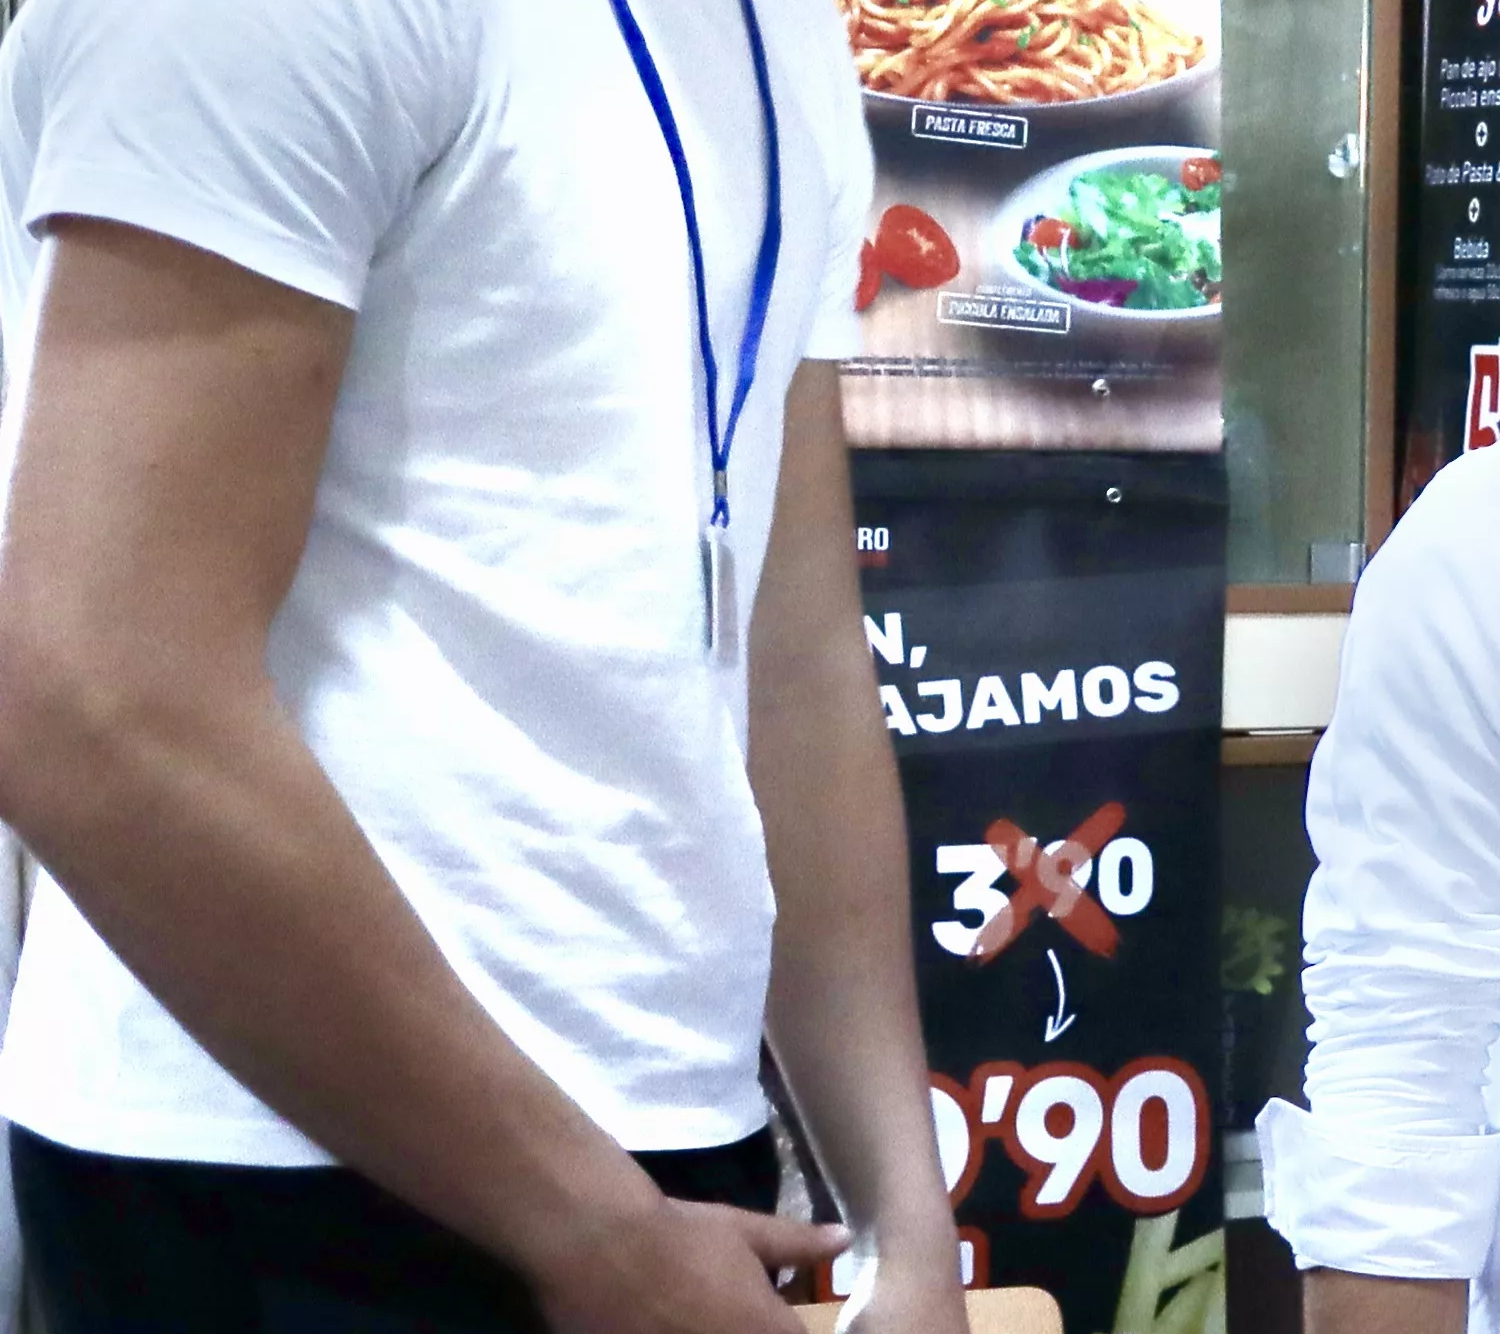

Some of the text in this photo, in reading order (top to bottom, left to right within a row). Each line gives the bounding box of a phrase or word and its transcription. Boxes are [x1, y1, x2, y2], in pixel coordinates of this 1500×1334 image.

[925, 114, 1017, 140] PASTA FRESCA
[1462, 160, 1493, 183] Pasta
